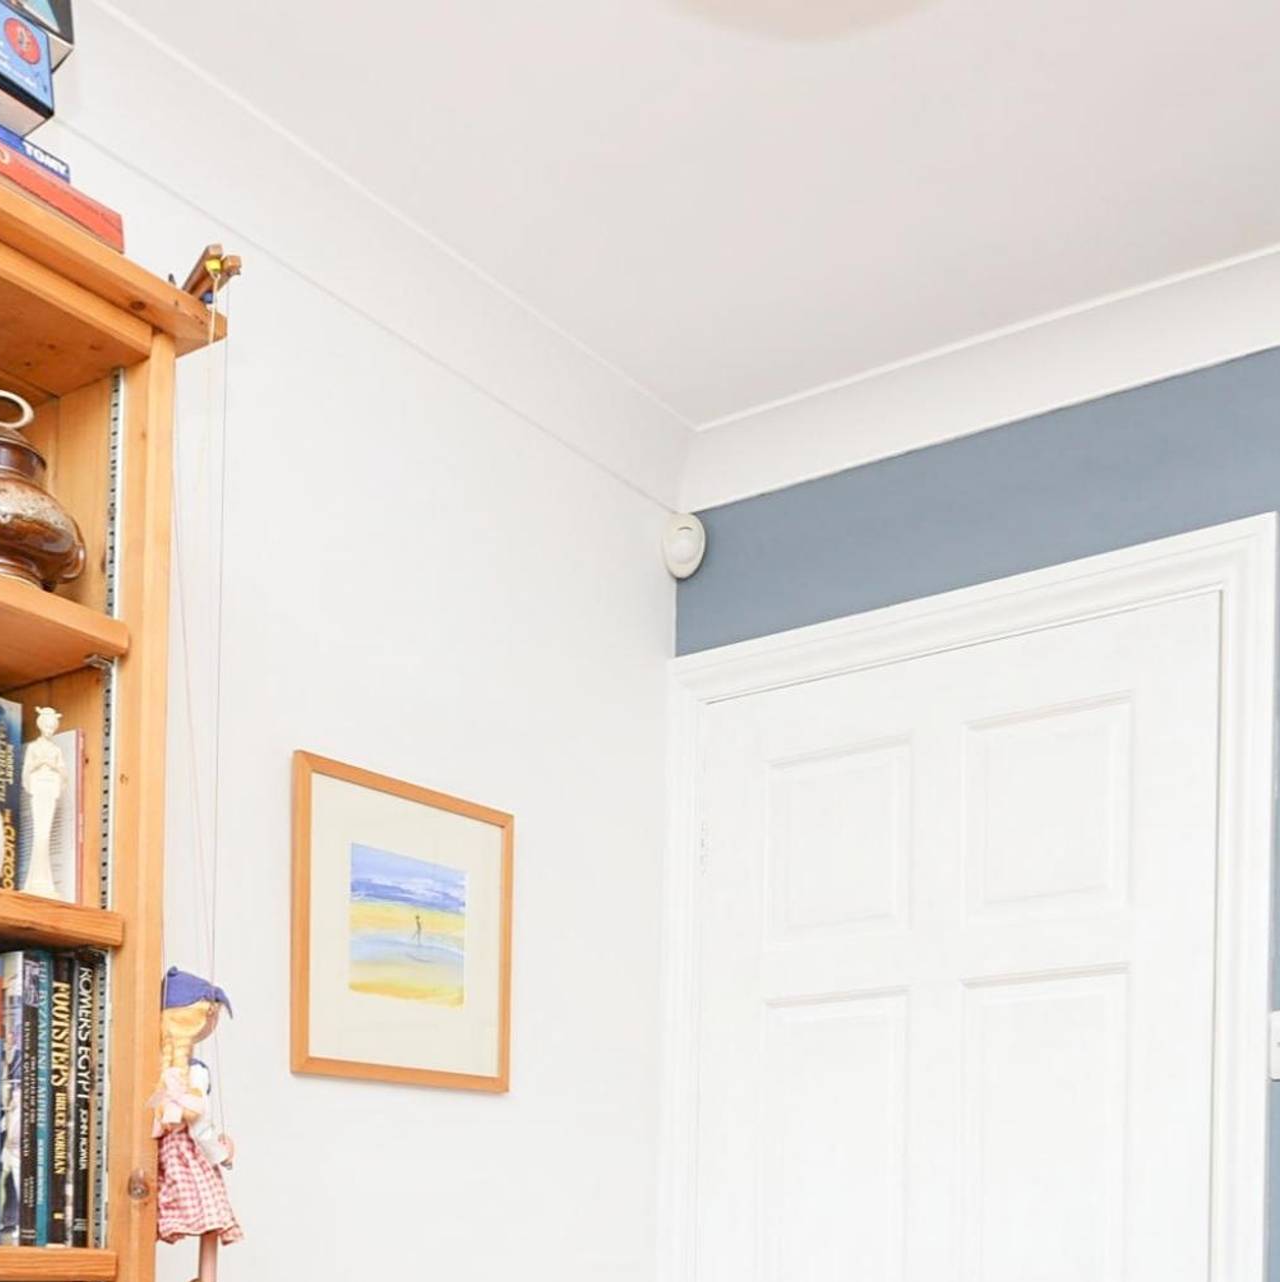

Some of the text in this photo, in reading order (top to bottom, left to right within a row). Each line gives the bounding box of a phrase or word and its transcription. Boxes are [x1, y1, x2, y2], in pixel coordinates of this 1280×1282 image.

[23, 141, 69, 177] TOMY
[2, 824, 17, 891] CUCKOO
[38, 988, 49, 1066] BYZANTINE
[37, 1070, 48, 1128] EMPIRE
[51, 981, 71, 1175] FOOTSTEPS BRUCE NORMAN
[77, 1045, 91, 1100] EGYPT
[78, 1108, 89, 1140] JOHN
